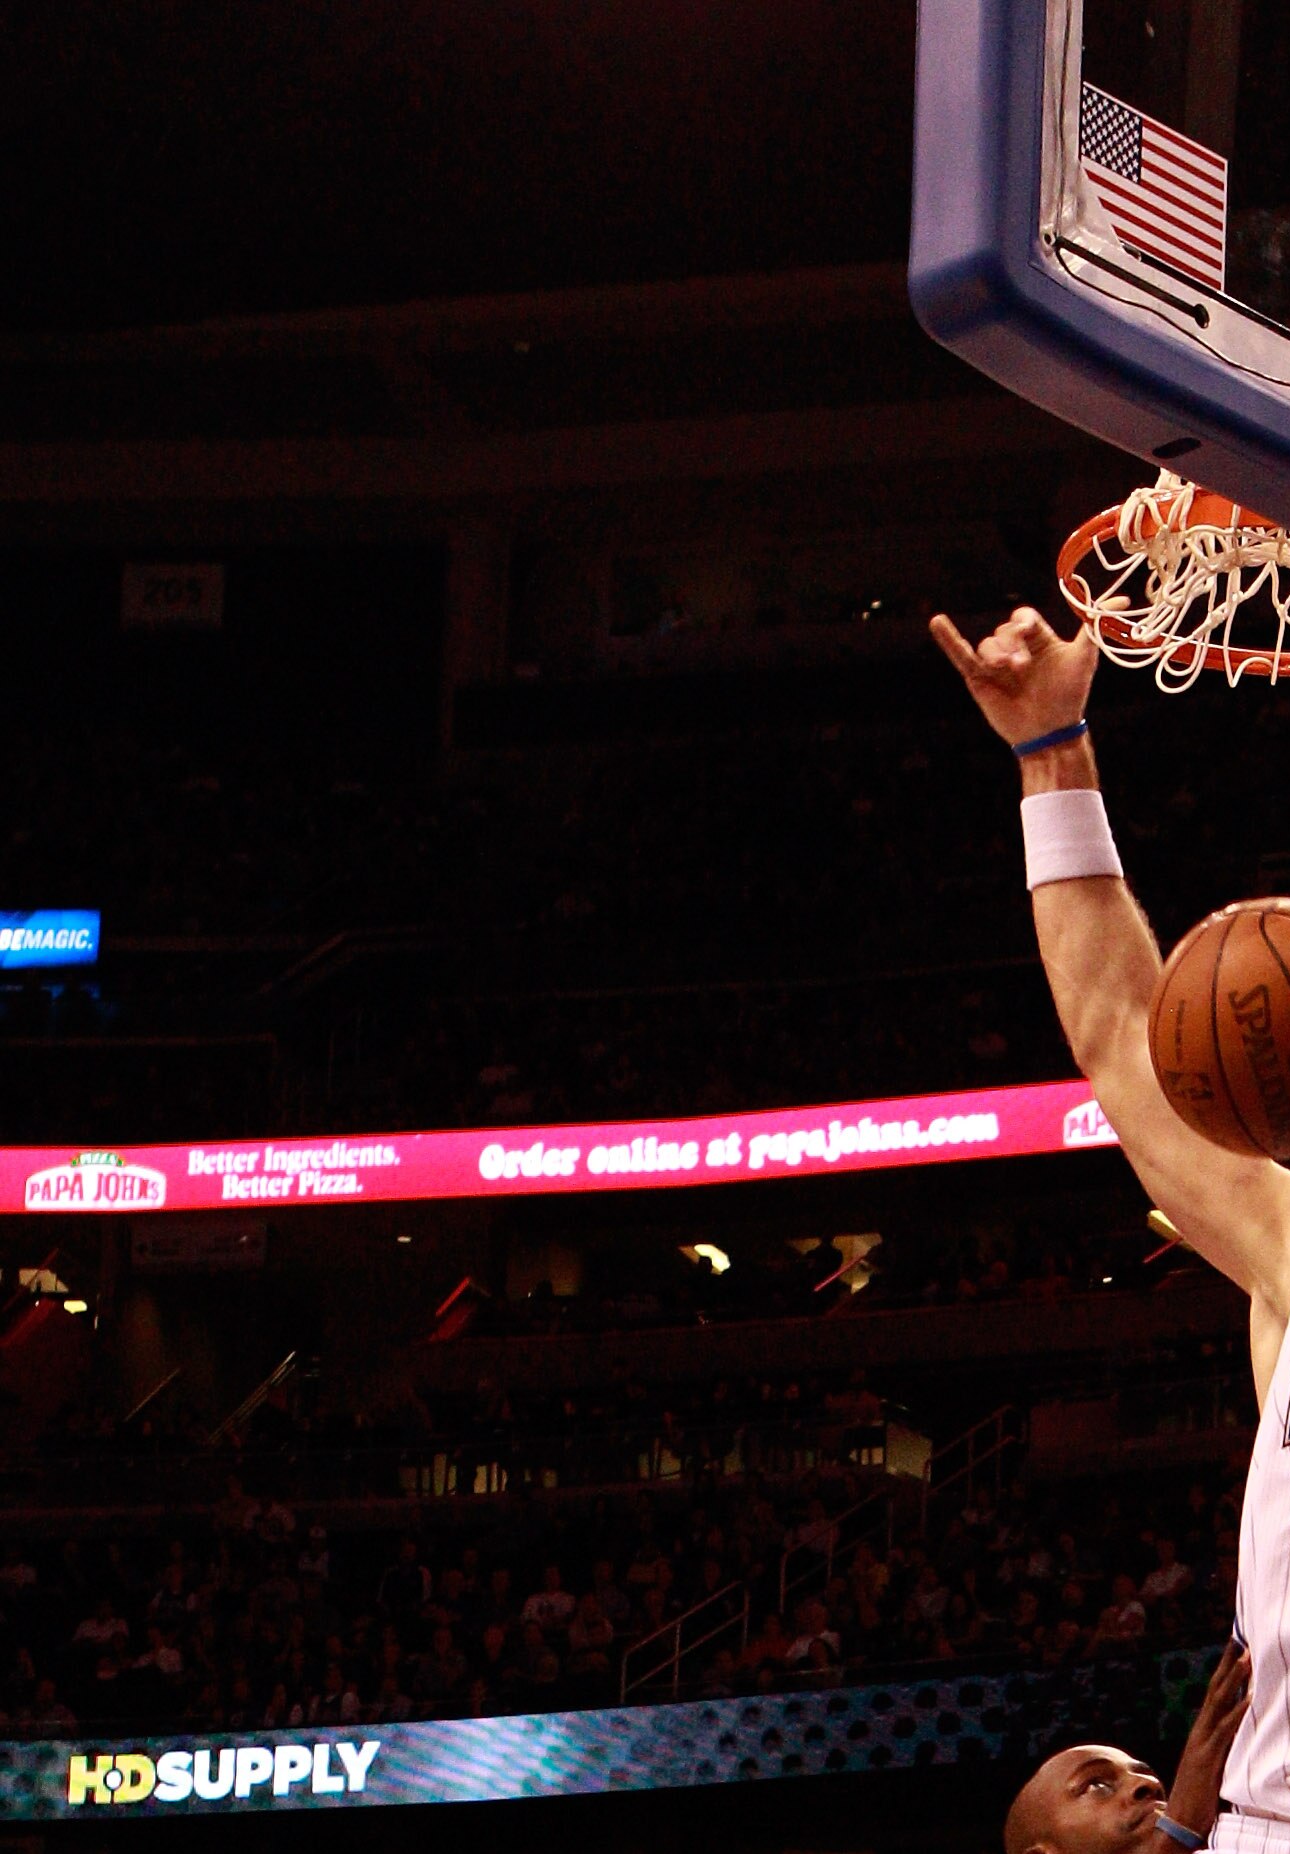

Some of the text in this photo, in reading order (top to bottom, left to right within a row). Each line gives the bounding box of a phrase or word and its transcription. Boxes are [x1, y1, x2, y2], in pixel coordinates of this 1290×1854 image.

[1066, 1106, 1114, 1137] PAP
[188, 1143, 401, 1175] Better Ingredients.
[479, 1111, 1000, 1180] Order online at papajohns.com
[29, 1173, 85, 1202] PAPA
[222, 1171, 363, 1200] Better Pizza.
